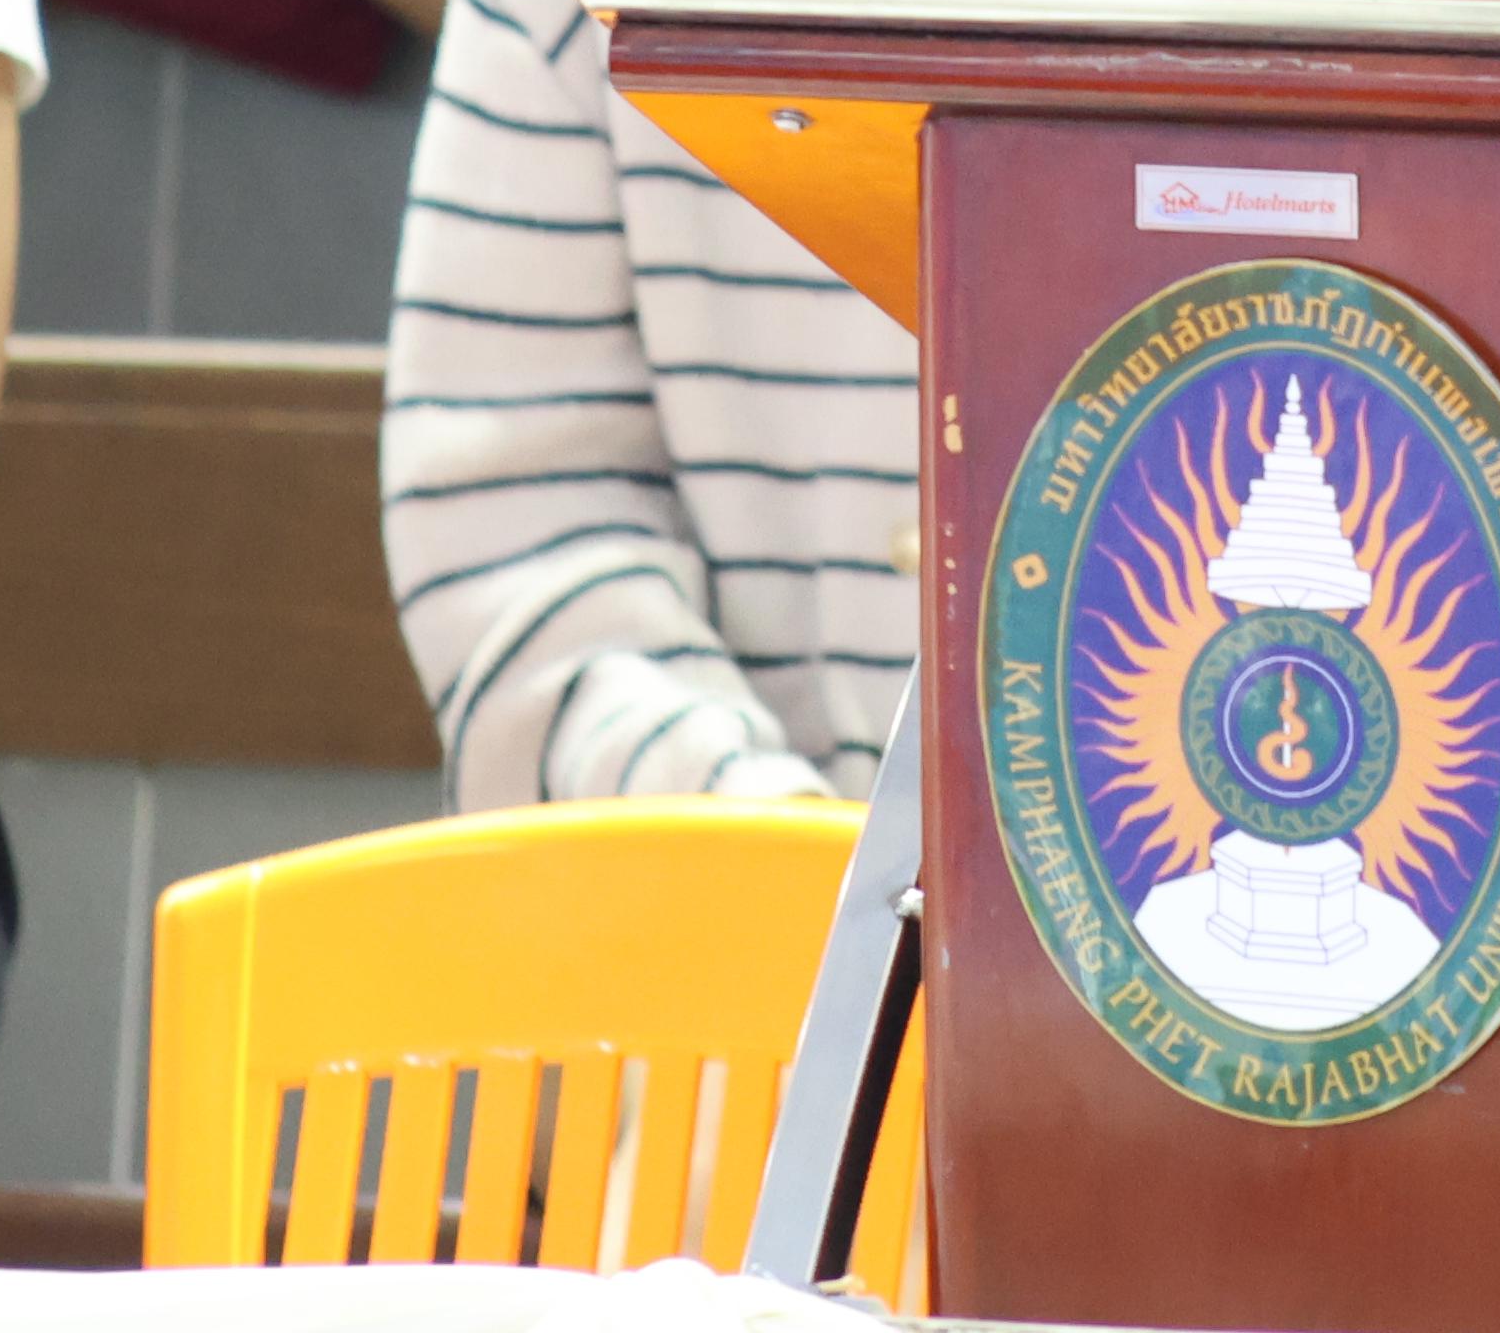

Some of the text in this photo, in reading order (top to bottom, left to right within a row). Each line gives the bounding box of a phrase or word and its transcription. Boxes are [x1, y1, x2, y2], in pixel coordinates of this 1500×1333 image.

[1002, 659, 1121, 976] KAMPHAENG
[1109, 976, 1224, 1079] PHET
[1232, 994, 1460, 1116] RAJABHAT
